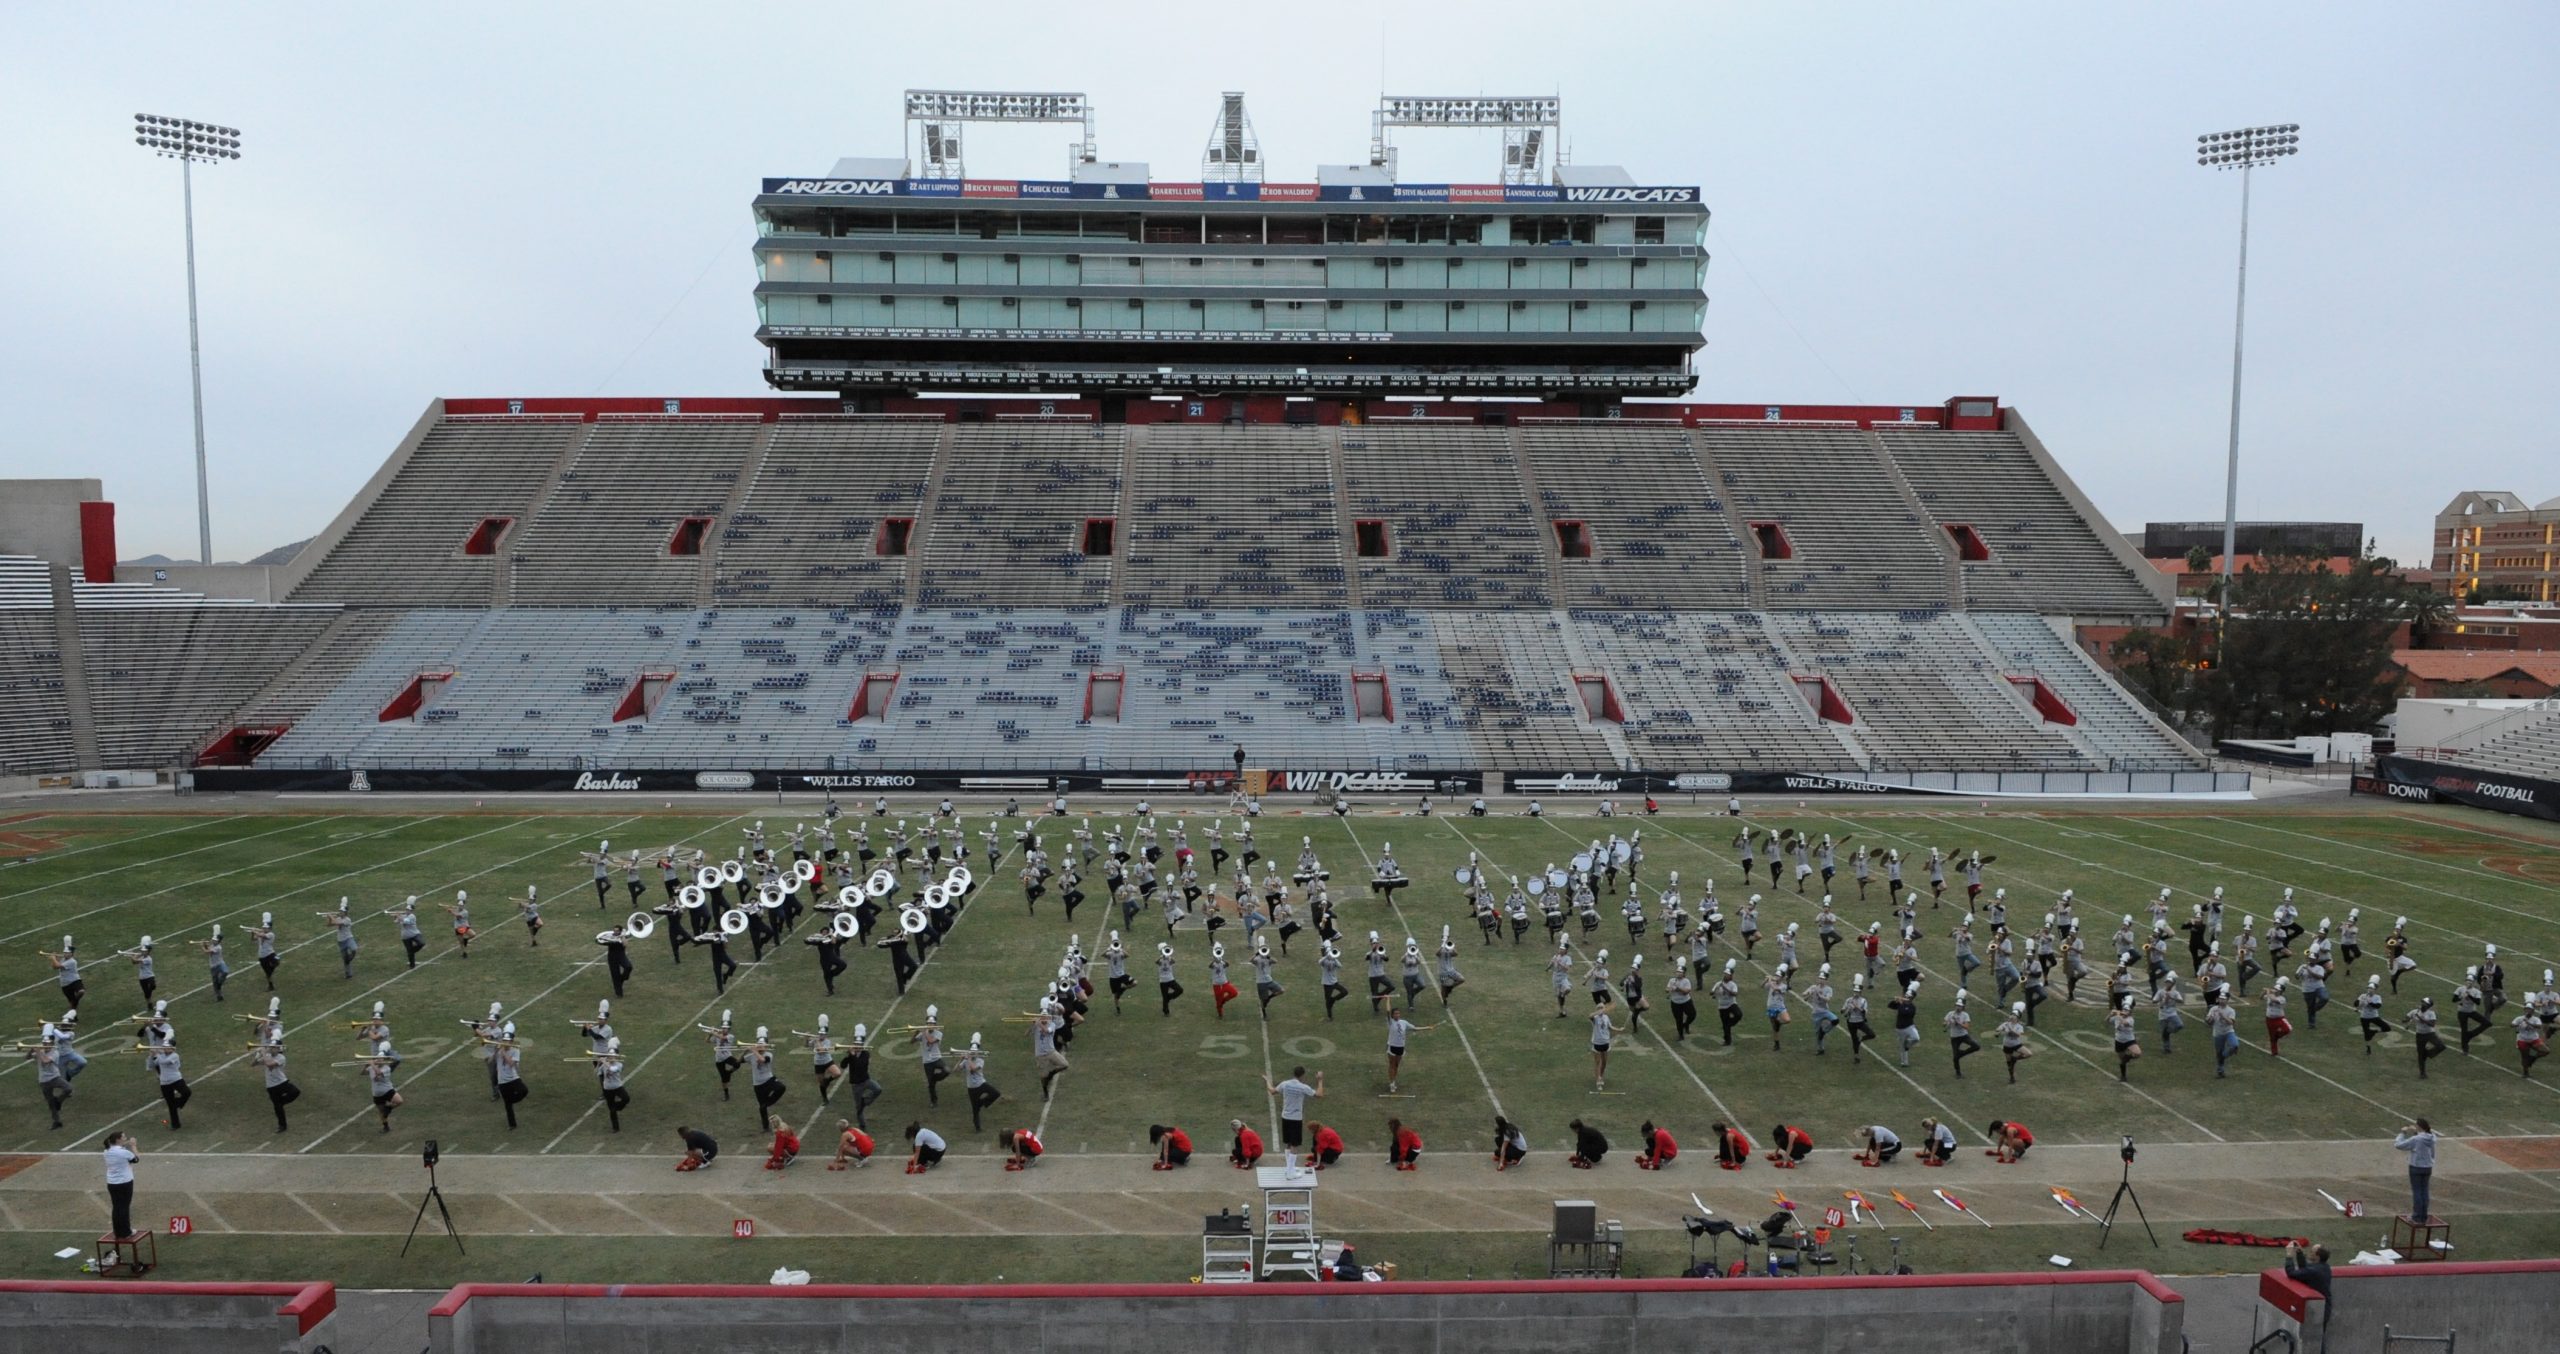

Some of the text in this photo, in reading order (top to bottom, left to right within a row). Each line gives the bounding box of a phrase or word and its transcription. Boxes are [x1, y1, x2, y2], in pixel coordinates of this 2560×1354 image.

[776, 181, 894, 194] ARIZONA
[931, 184, 960, 192] LUPPINO
[993, 185, 1018, 193] HUNLEY
[1028, 185, 1051, 194] CHUCK
[1052, 186, 1070, 194] CECIL
[1154, 187, 1182, 195] DARRYLL
[1183, 188, 1203, 196] LEWIS
[1282, 188, 1314, 196] WALDROP
[1510, 189, 1536, 197] ANTOINE
[1537, 190, 1559, 198] CASON
[1567, 188, 1693, 201] WILDCATS
[510, 404, 521, 414] 17
[666, 404, 678, 414] 18
[843, 405, 855, 415] 19
[1041, 406, 1054, 415] 20
[1191, 405, 1202, 415] 21
[1412, 408, 1425, 417] 22
[1608, 409, 1620, 418] 23
[1766, 411, 1779, 420] 24
[1901, 412, 1914, 421] 25
[155, 571, 166, 580] 16
[573, 771, 642, 791] Bashas'
[810, 775, 915, 787] WELLS FARGO
[1184, 771, 1287, 793] ARIZA
[1784, 776, 1889, 793] WELLS FARGO
[2356, 779, 2429, 800] BEAR DOWN
[2476, 782, 2535, 803] FOOTBALL
[1200, 1035, 1337, 1058] 50
[2348, 1201, 2364, 1217] 30
[1279, 1210, 1295, 1224] 50
[1826, 1208, 1840, 1225] 40
[171, 1217, 188, 1234] 30
[735, 1220, 752, 1236] 40
